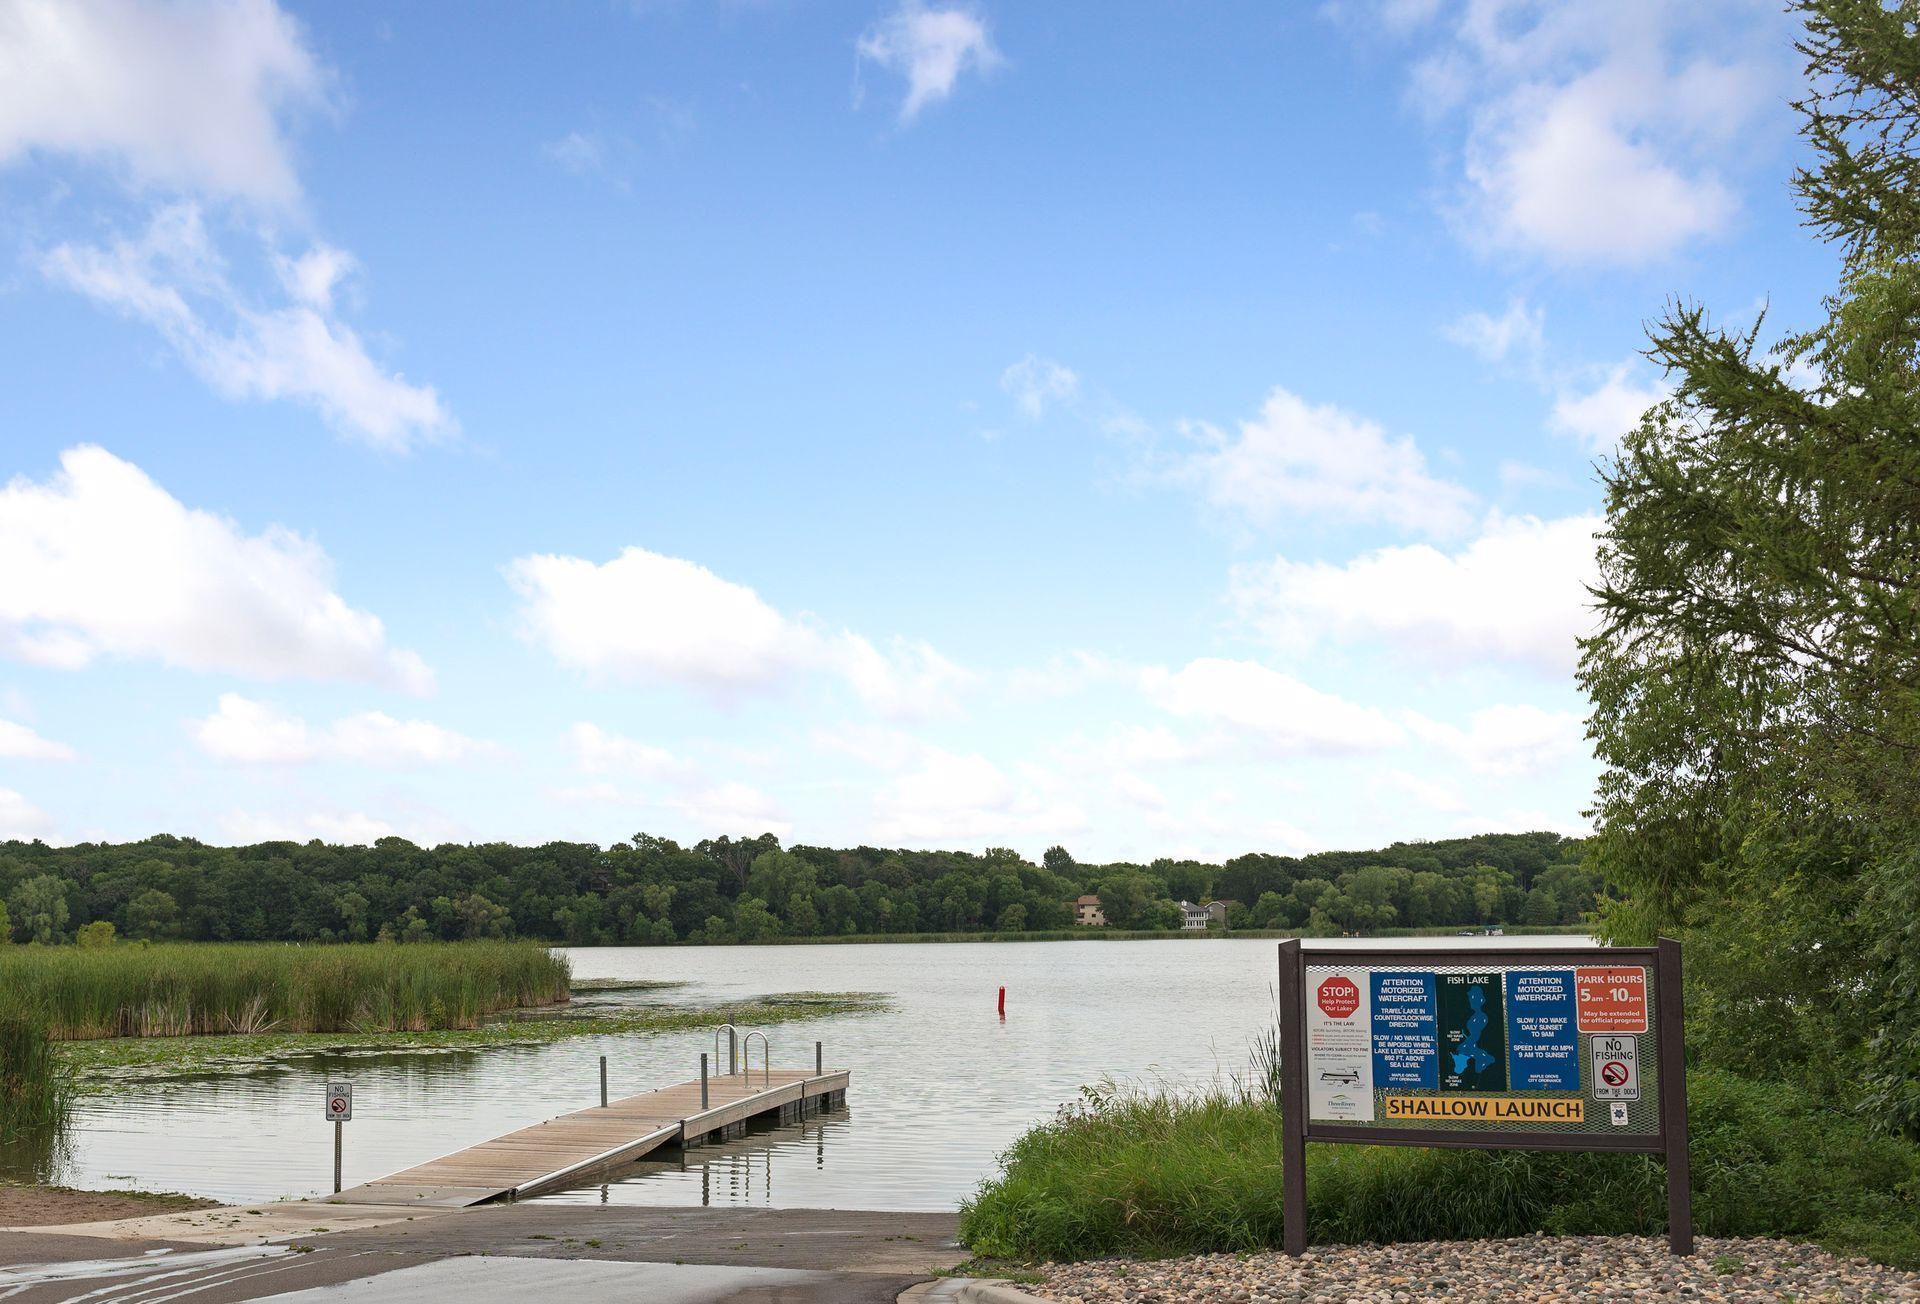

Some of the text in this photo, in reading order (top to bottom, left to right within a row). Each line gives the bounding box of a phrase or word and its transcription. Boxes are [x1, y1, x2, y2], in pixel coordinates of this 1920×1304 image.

[1578, 976, 1643, 984] PARK HOURS
[1322, 986, 1354, 997] STOP!
[1605, 1041, 1622, 1051] NO
[1595, 1051, 1634, 1060] FISHING
[1389, 1099, 1581, 1118] SHALLOW LAUNCH
